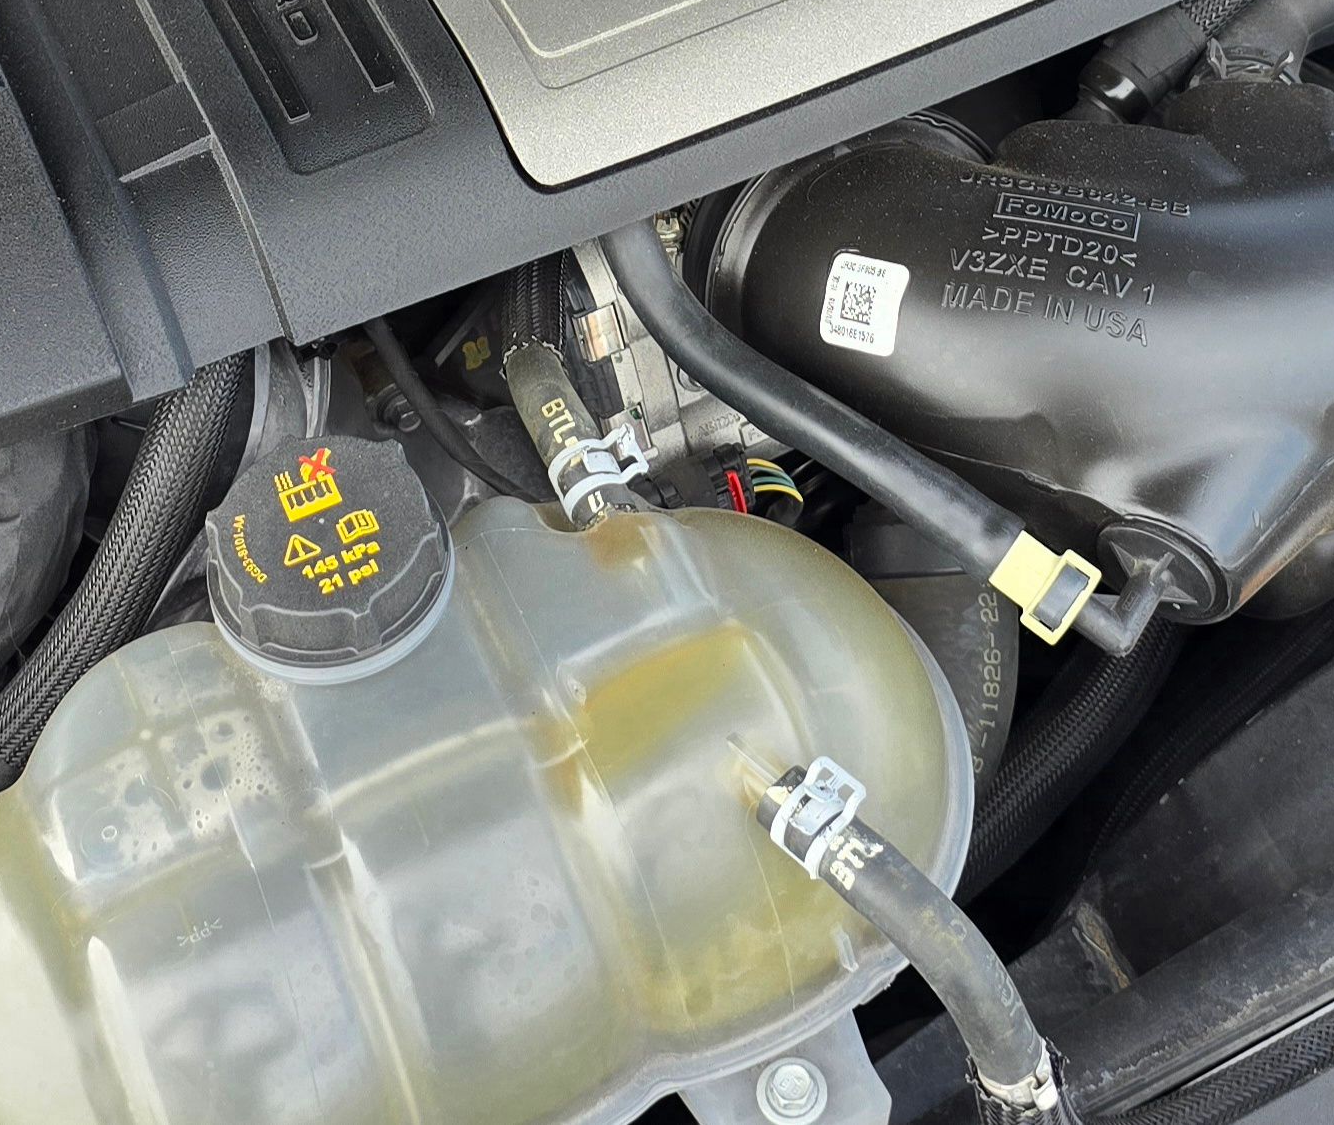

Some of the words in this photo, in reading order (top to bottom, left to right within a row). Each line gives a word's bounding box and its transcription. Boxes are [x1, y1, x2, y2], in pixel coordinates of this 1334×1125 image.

[1005, 197, 1128, 233] FoMoCo
[949, 247, 1049, 281] V3ZXE
[1065, 264, 1134, 299] CAV
[1142, 282, 1156, 306] 1
[940, 280, 1035, 316] MADE
[1043, 294, 1076, 324] IN
[1085, 304, 1149, 346] USA
[301, 555, 339, 579] 145
[340, 541, 381, 564] kPa
[318, 573, 344, 594] 21
[348, 558, 379, 585] psi
